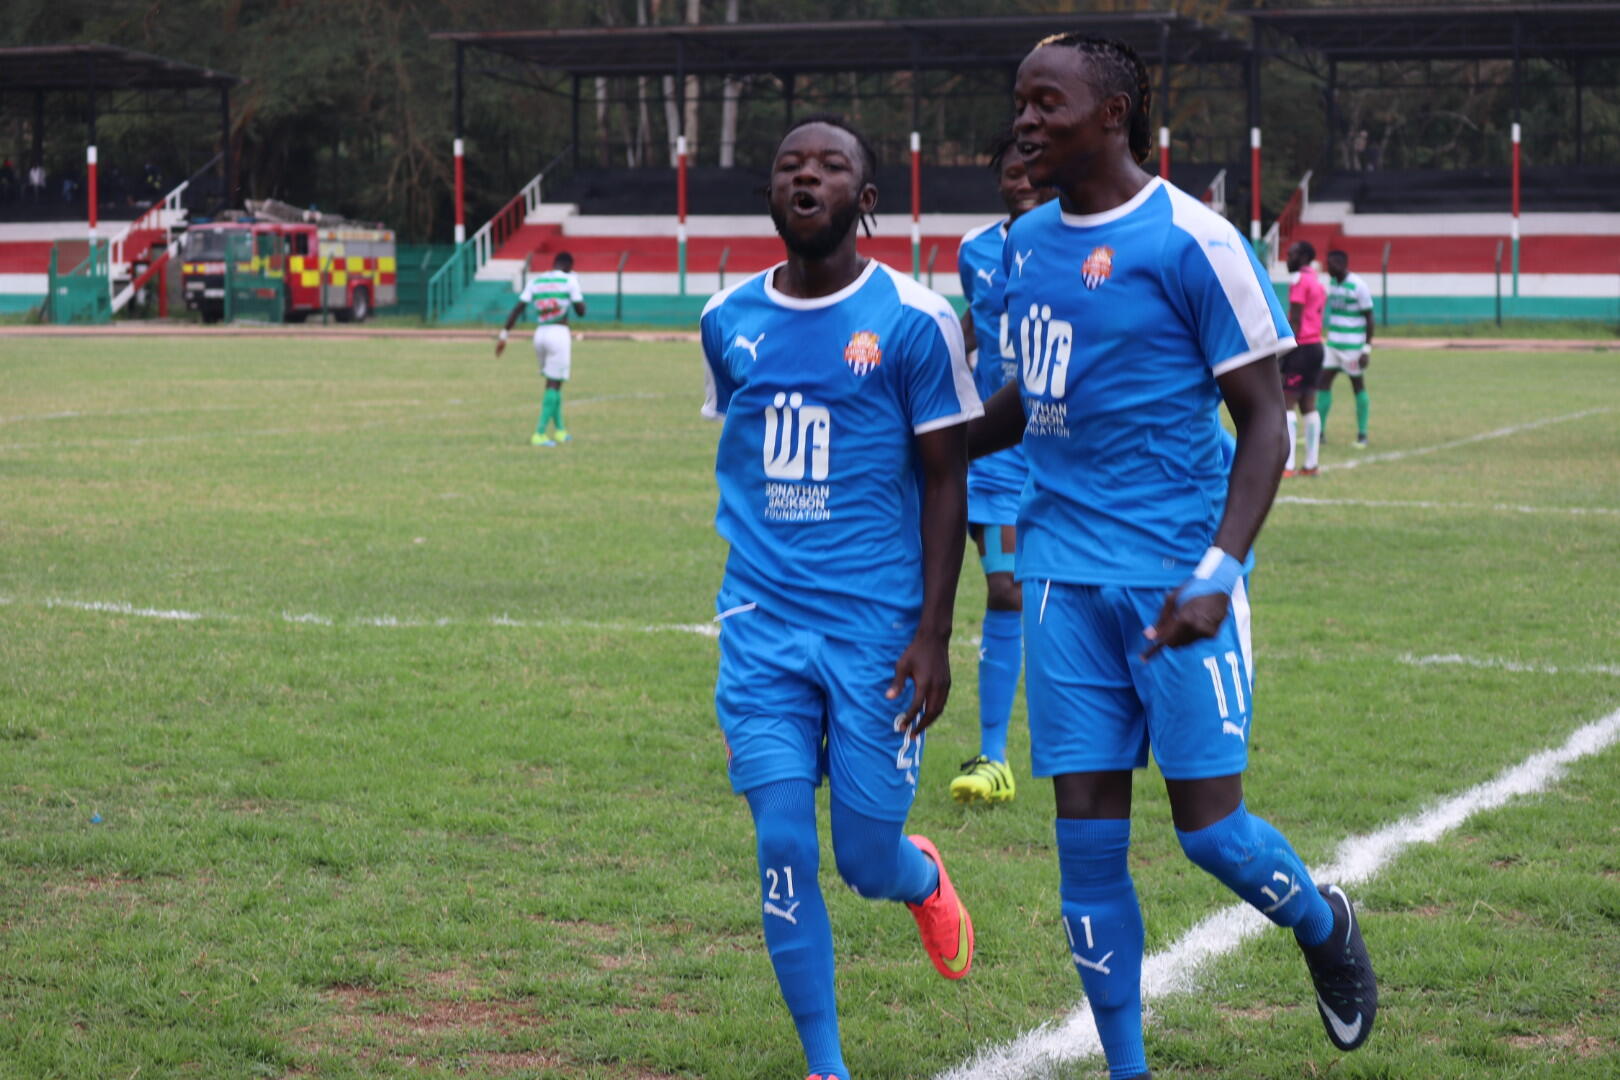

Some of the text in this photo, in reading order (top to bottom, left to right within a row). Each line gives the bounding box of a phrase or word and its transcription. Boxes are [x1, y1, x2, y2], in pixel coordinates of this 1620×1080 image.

[765, 482, 830, 499] JONATHAN
[768, 496, 826, 511] JACKSON
[764, 506, 831, 521] FOUNDATION
[1203, 650, 1246, 719] 11
[766, 866, 794, 900] 21
